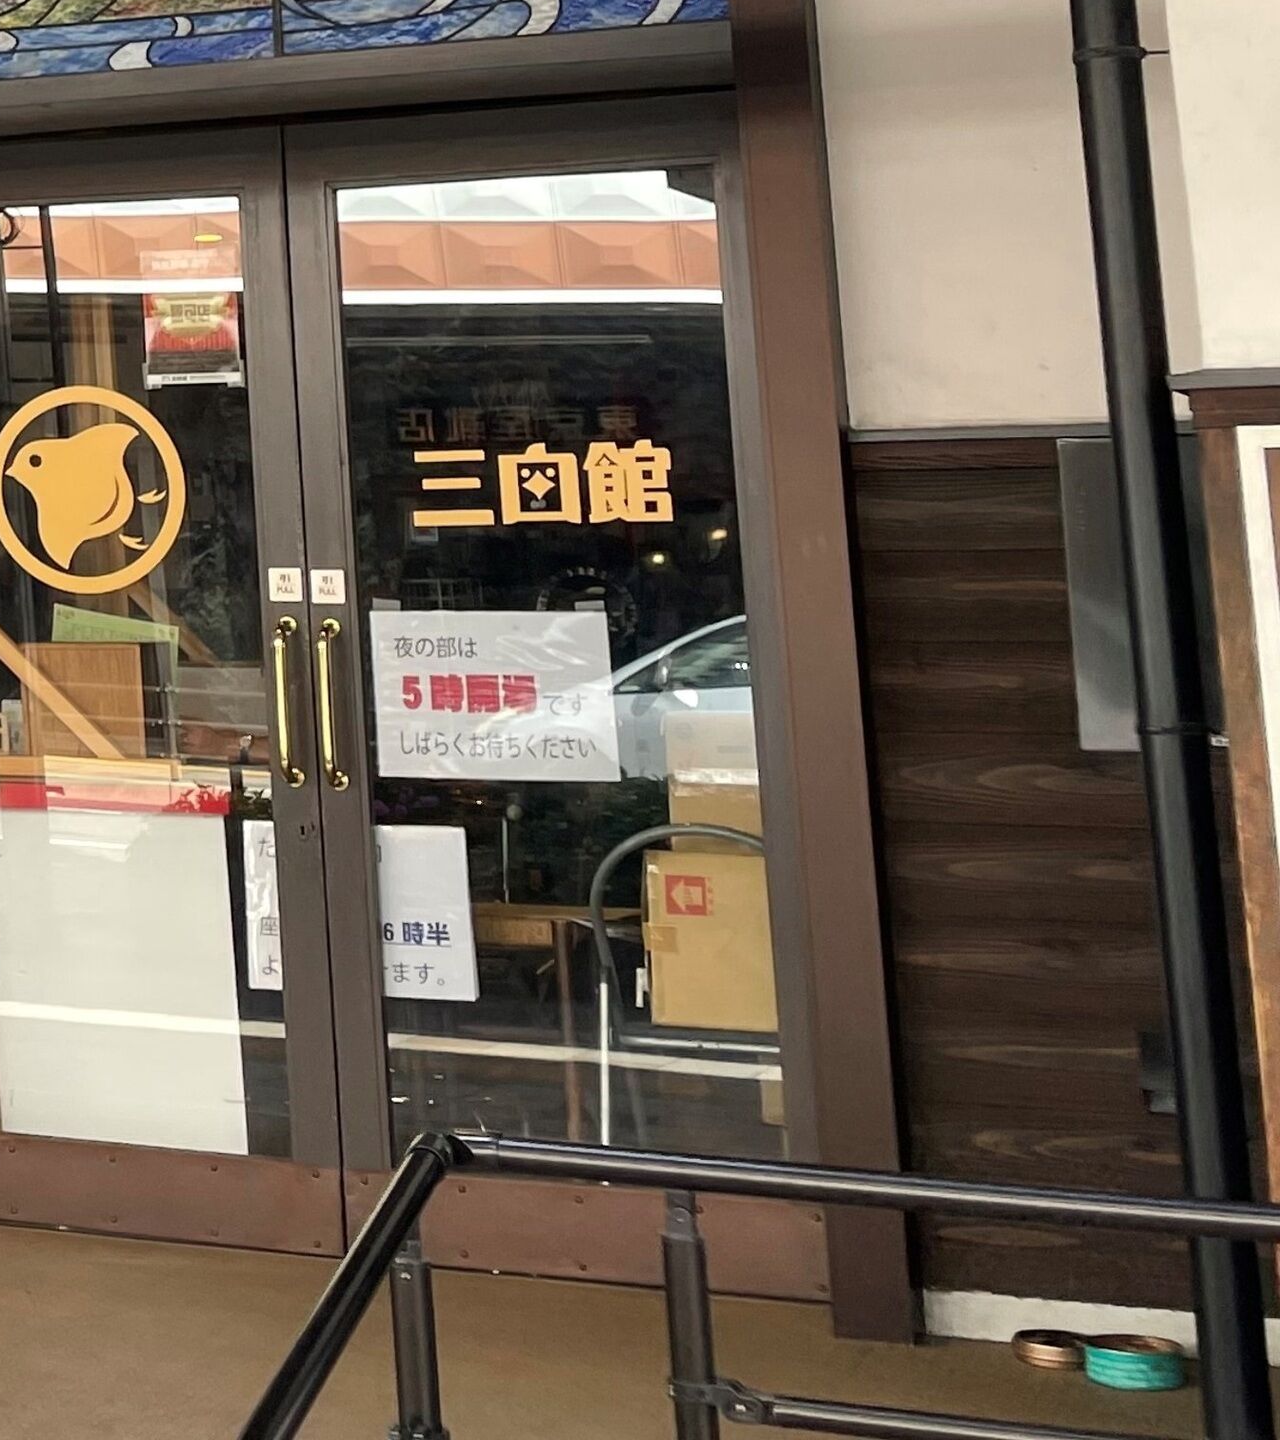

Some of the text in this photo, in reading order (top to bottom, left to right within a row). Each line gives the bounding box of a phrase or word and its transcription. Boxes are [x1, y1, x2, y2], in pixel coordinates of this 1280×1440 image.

[393, 636, 478, 658] 夜の部は
[399, 730, 597, 759] しばらくお待ちください
[384, 961, 445, 986] ます。
